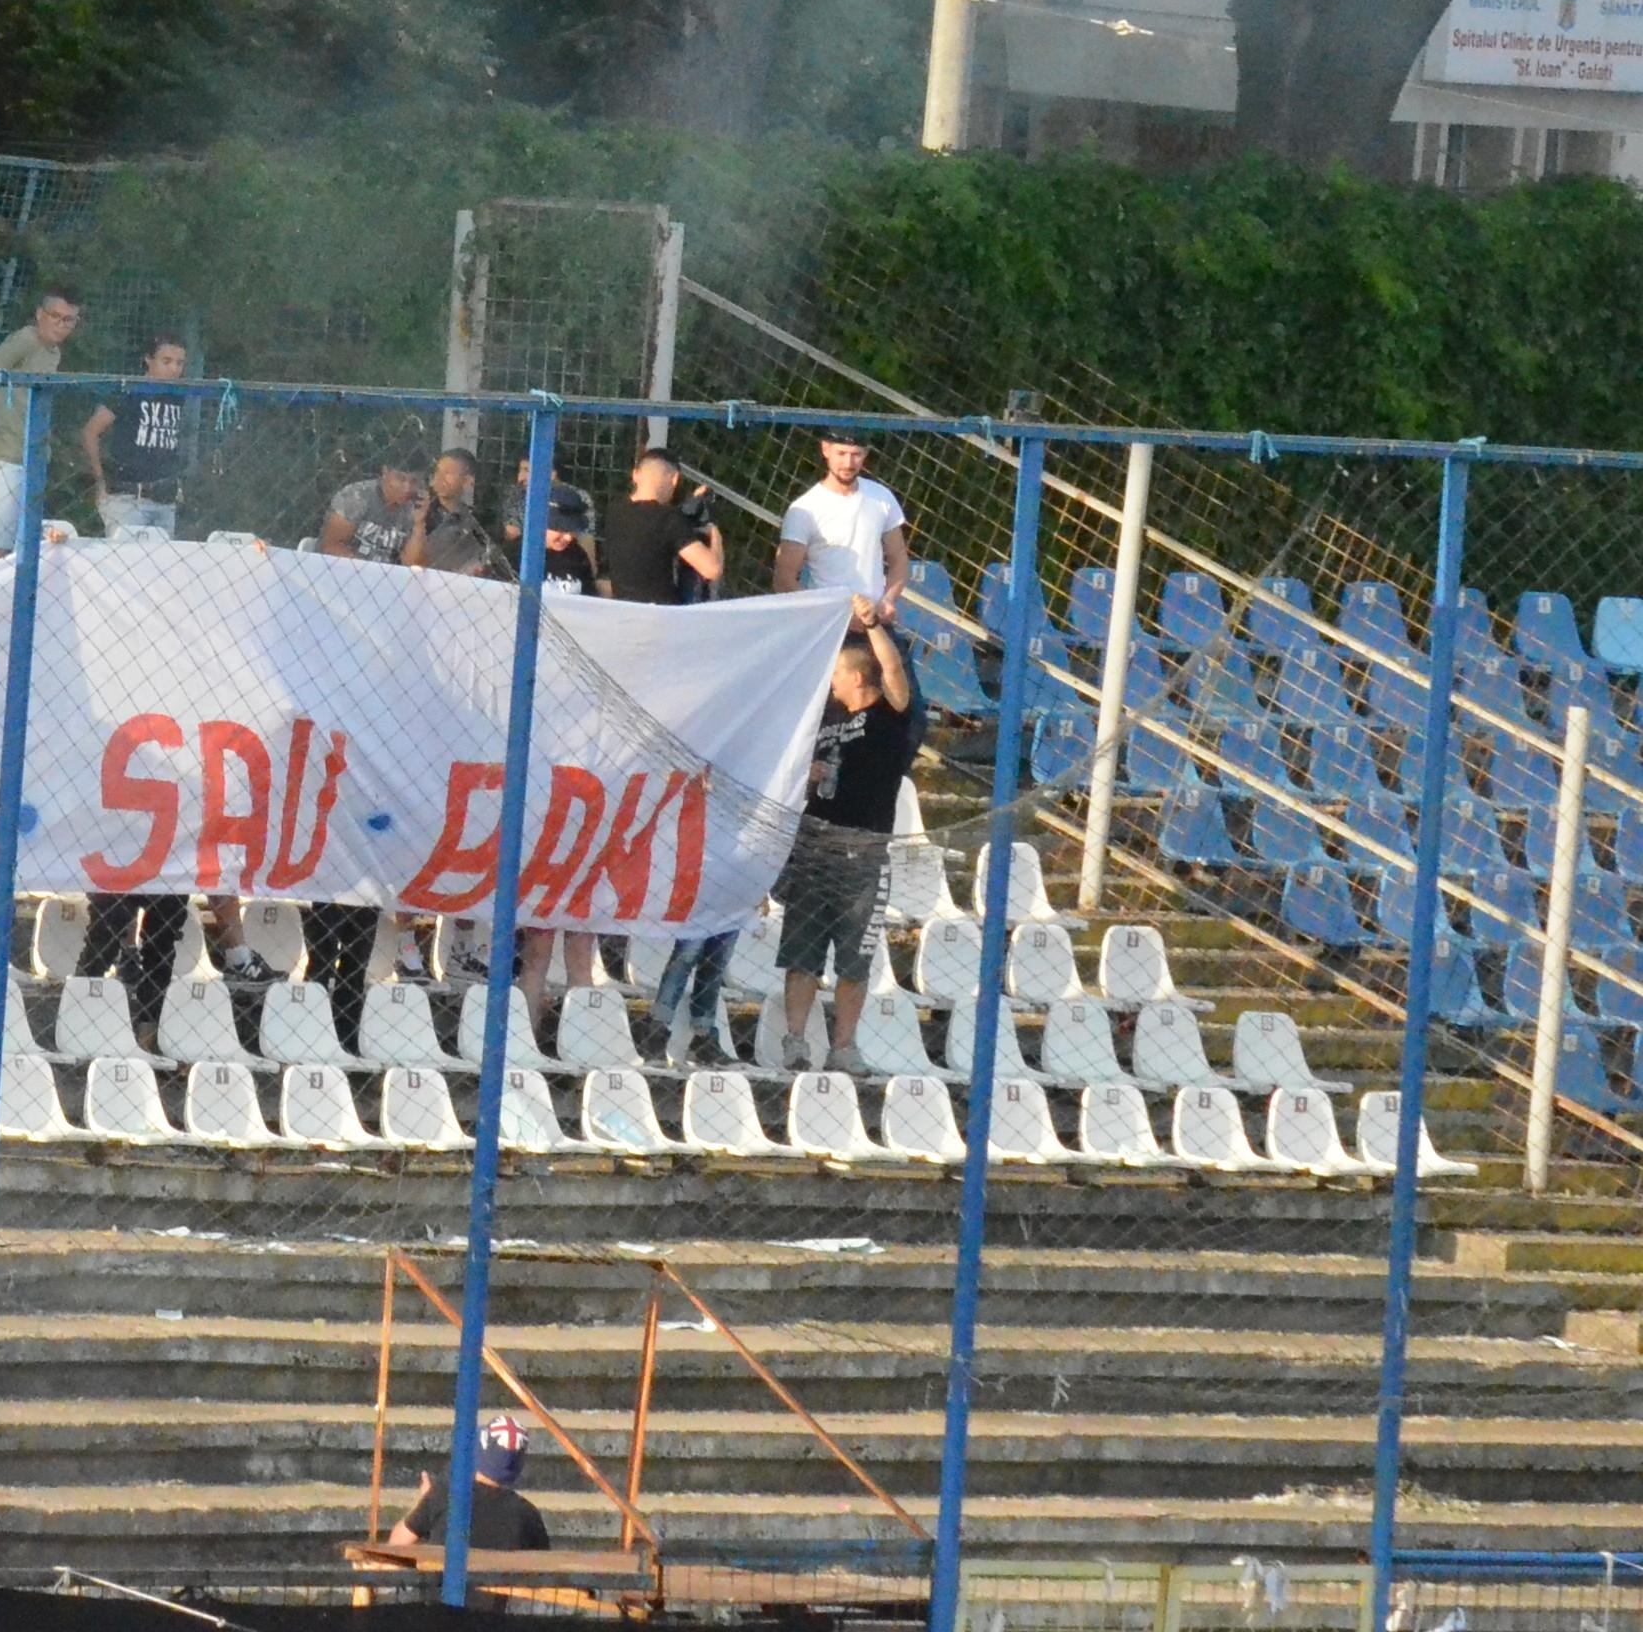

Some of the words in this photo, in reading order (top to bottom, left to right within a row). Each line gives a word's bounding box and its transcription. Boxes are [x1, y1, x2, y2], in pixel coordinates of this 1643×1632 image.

[1452, 27, 1497, 50] Spitalul
[1501, 31, 1534, 52] Clinic
[1537, 33, 1552, 52] de
[80, 712, 348, 894] SAU
[398, 761, 709, 923] BANI
